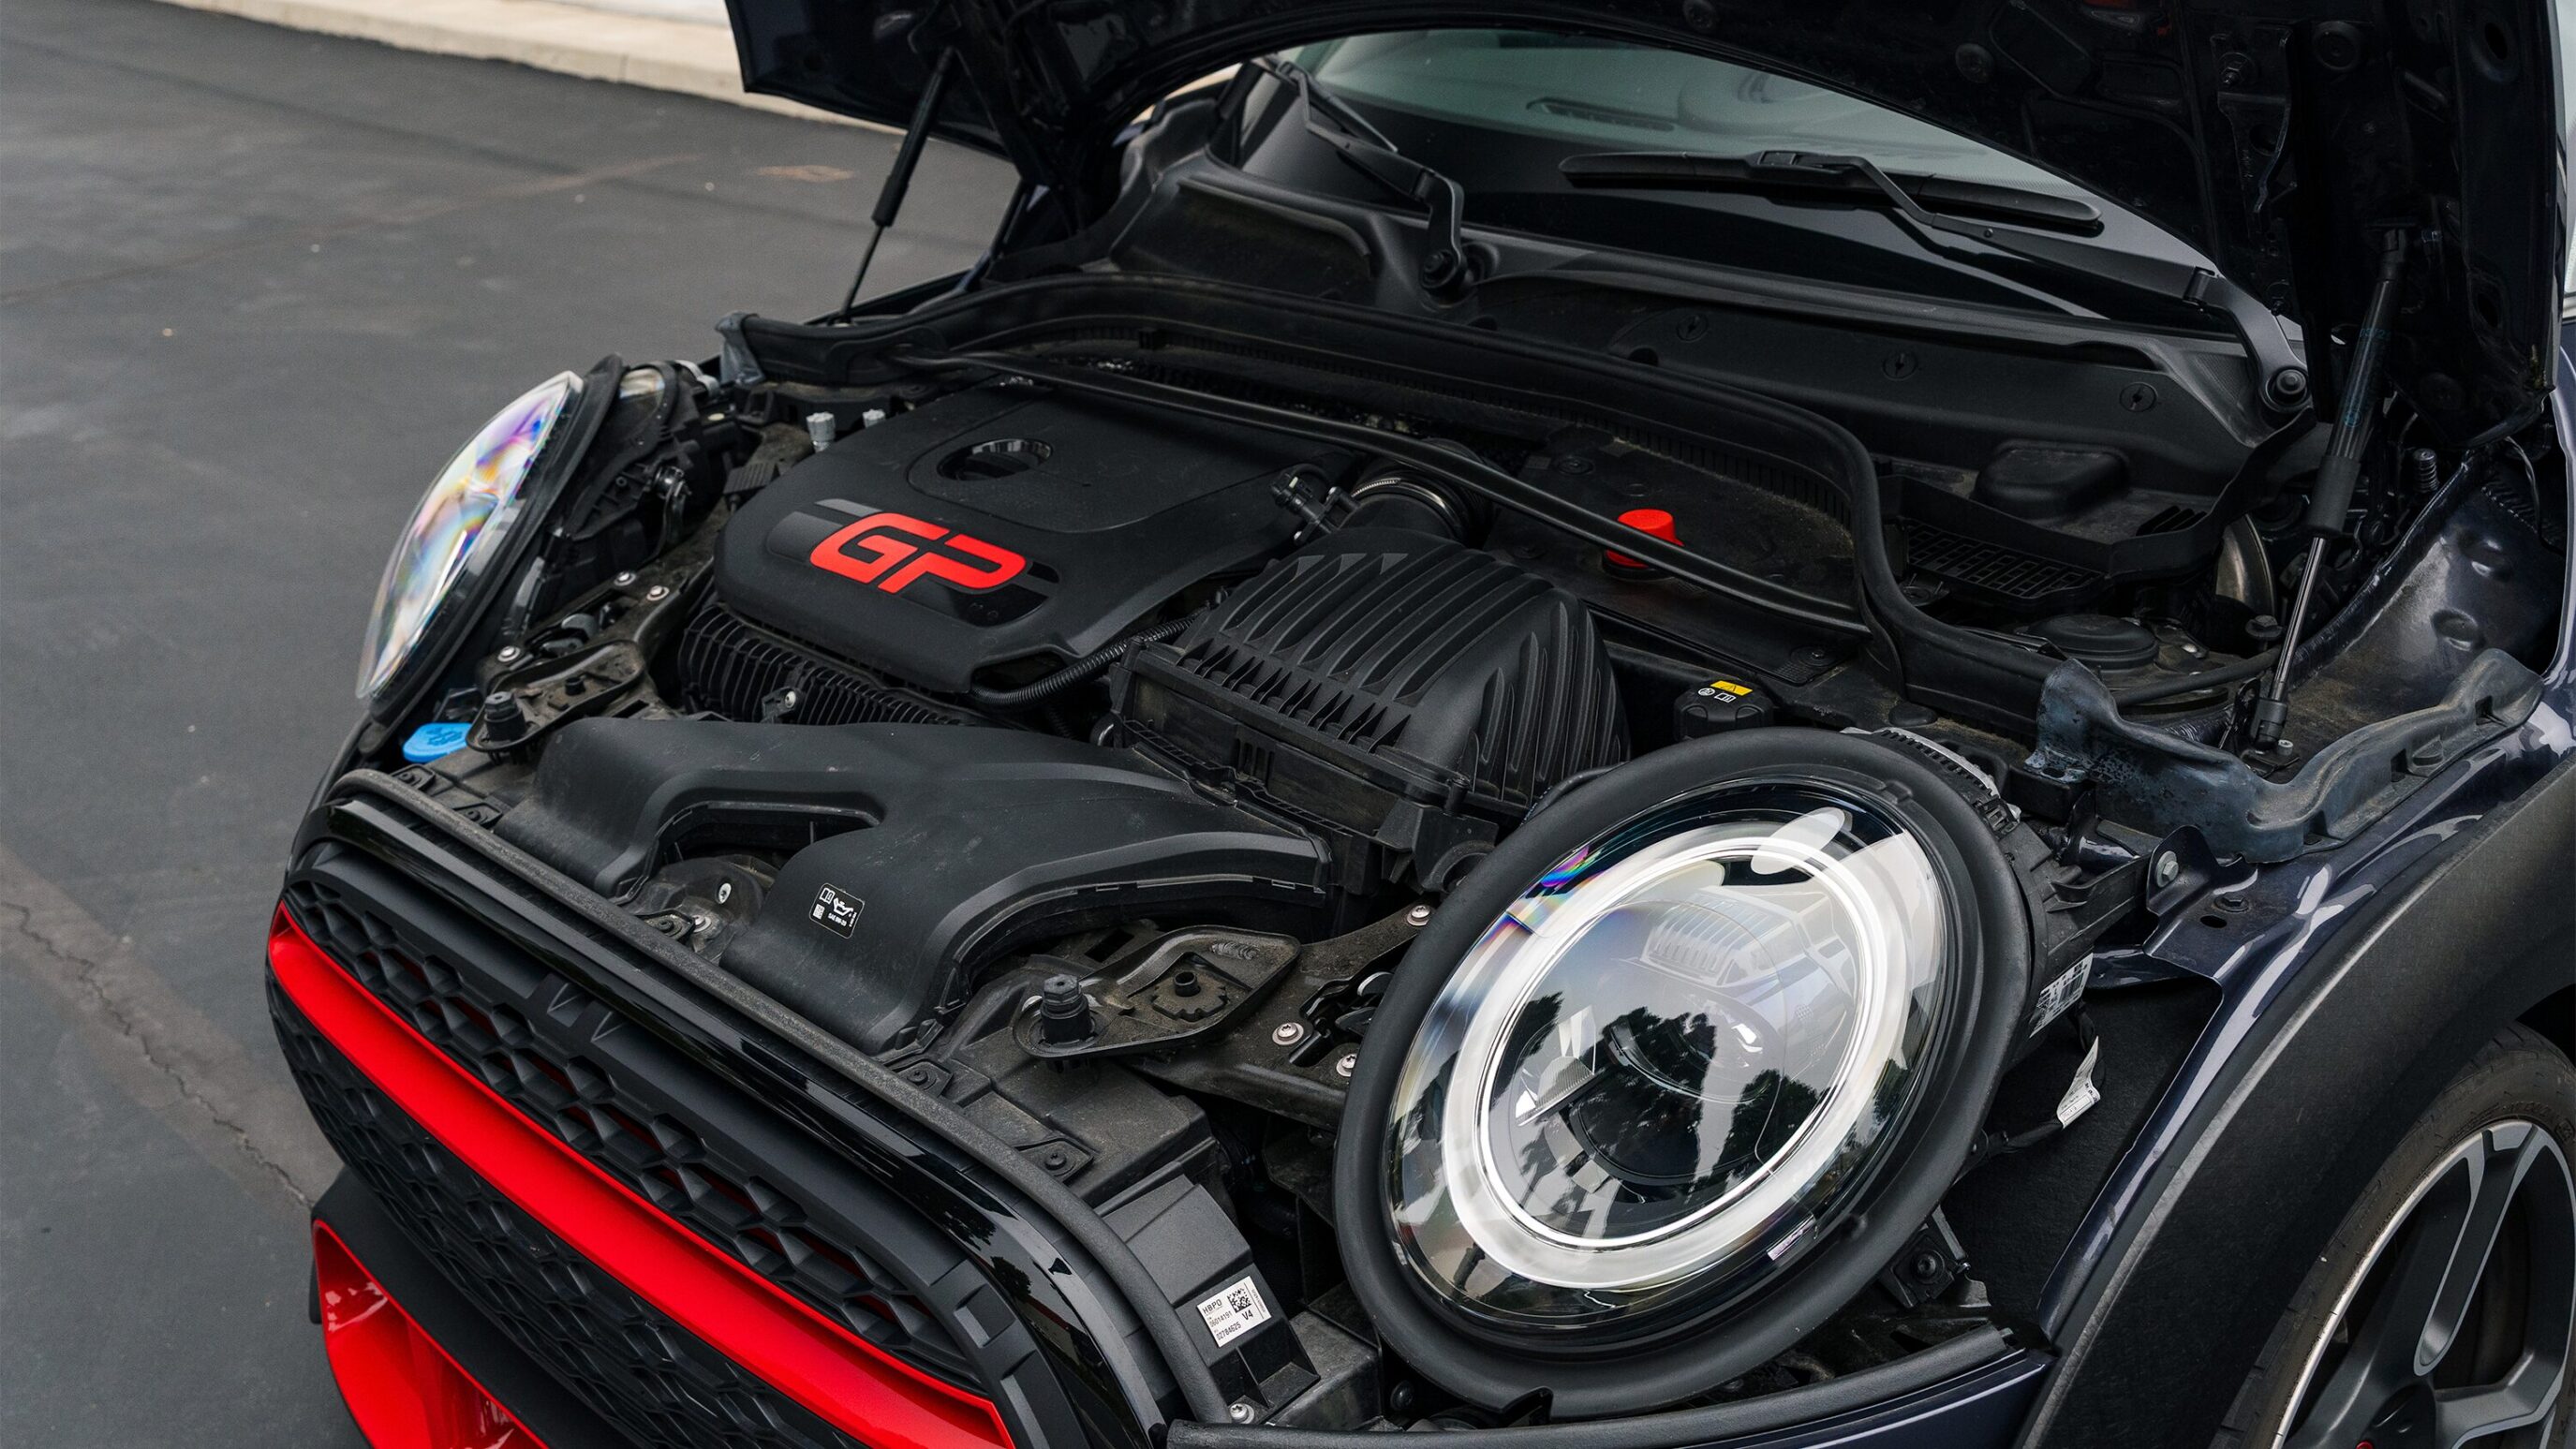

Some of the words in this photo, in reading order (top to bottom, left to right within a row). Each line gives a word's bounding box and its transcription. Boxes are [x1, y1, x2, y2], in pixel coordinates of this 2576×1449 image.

[809, 512, 1027, 594] GP
[1202, 1298, 1222, 1314] HBPO
[1241, 1309, 1253, 1321] V4
